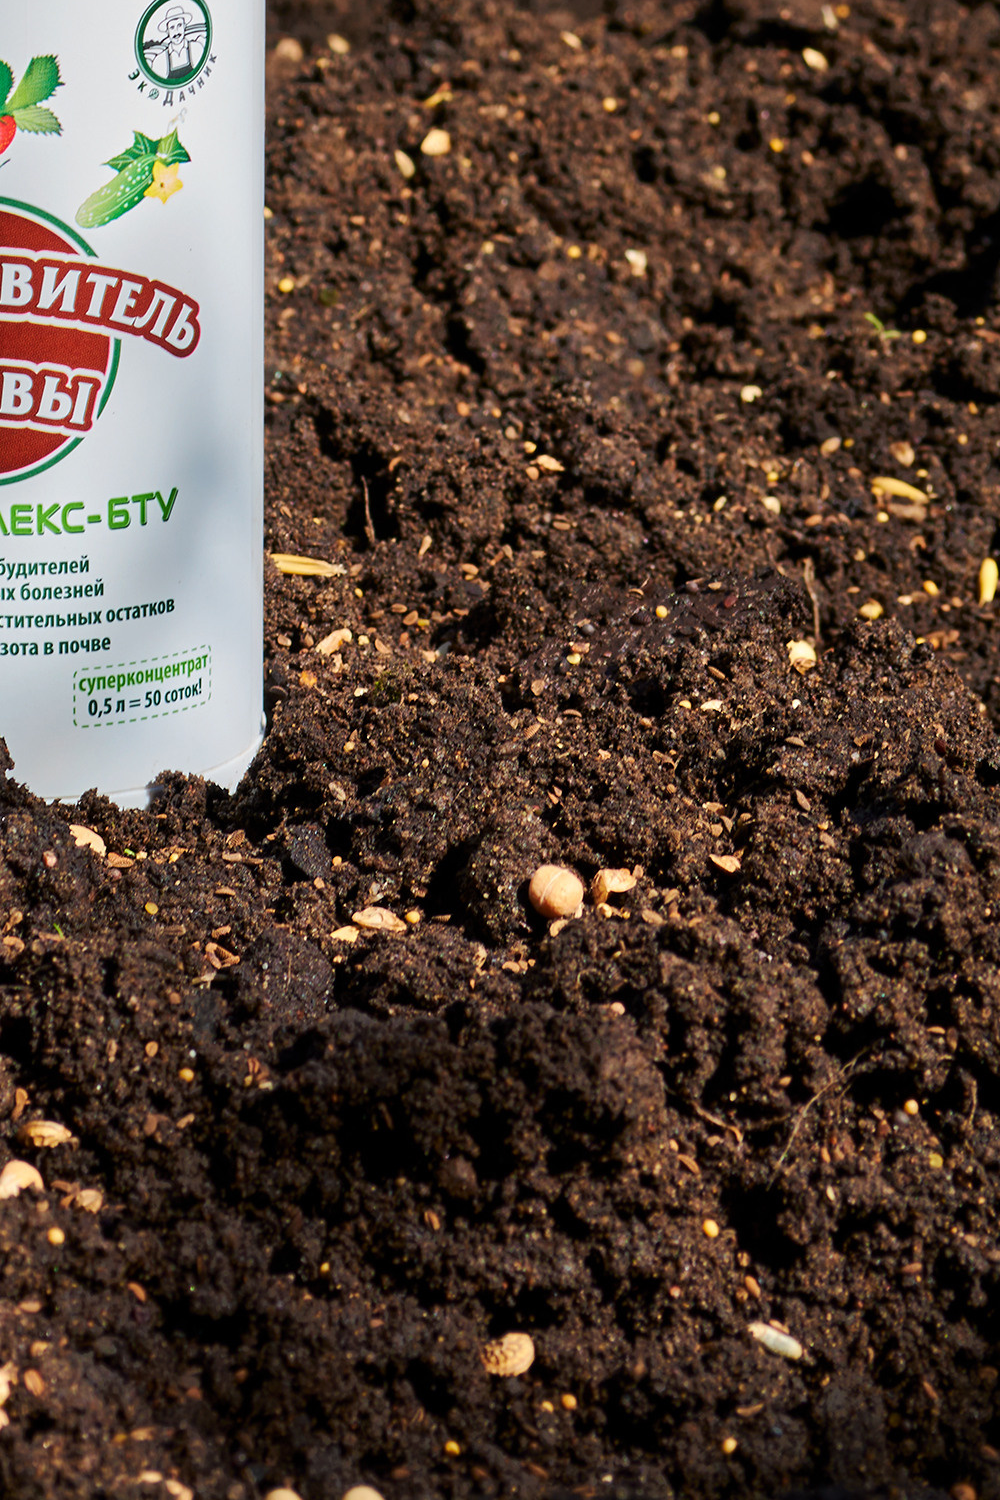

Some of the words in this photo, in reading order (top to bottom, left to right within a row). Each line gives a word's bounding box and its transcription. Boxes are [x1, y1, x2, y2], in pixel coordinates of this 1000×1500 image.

[20, 578, 105, 601] болезней
[106, 598, 176, 622] остатков
[44, 641, 54, 655] в
[58, 636, 111, 655] почве
[78, 654, 209, 696] суперконцентрат
[88, 697, 112, 718] 0,5
[115, 699, 126, 713] л
[145, 689, 162, 708] 50
[164, 677, 202, 704] соток!
